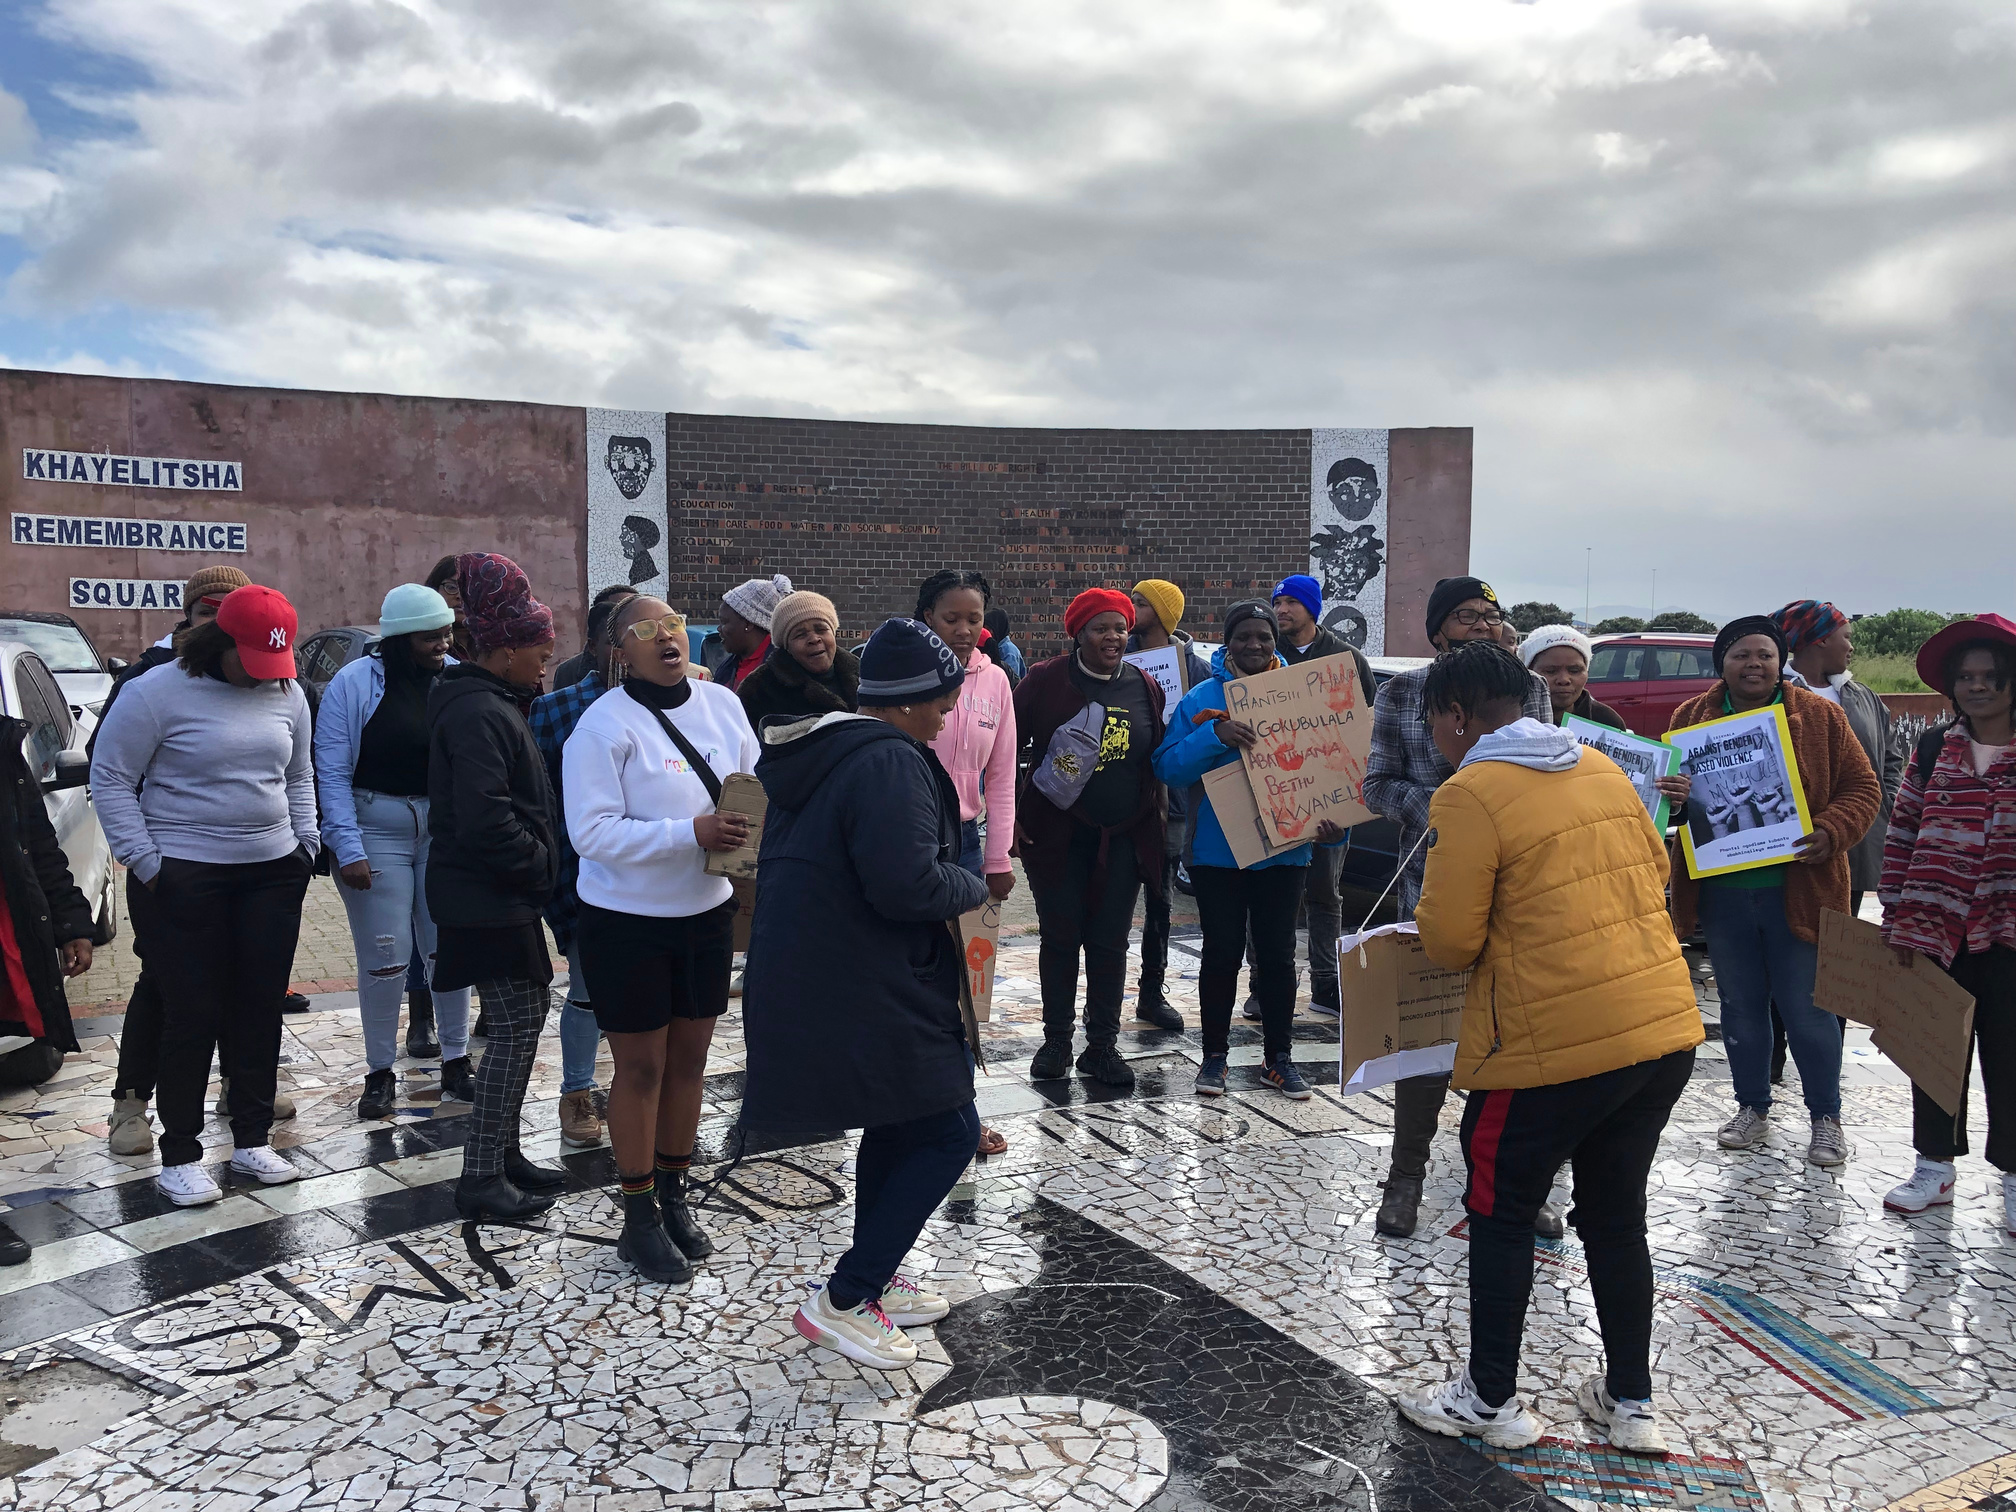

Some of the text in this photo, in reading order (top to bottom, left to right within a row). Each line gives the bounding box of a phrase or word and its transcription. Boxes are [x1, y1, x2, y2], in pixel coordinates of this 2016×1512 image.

[26, 452, 239, 488] KHAYELITSHA
[938, 463, 953, 471] THE
[960, 463, 978, 471] BILL
[988, 463, 999, 472] OF
[704, 482, 737, 492] HAVE
[773, 484, 807, 494] RIGHT
[680, 500, 734, 509] EDUCATION
[1020, 509, 1051, 518] HEALTH
[681, 519, 719, 528] HEALTH
[759, 520, 783, 530] FOOD
[791, 521, 825, 531] WATER
[833, 523, 851, 532] AND
[857, 523, 887, 532] SOCIAL
[899, 525, 940, 534] SECURITY
[14, 516, 245, 550] REMEMBRANCE
[680, 537, 734, 547] EQUALITY
[1008, 545, 1031, 553] JUST
[1038, 545, 1118, 554] ADMINISTRATIVE
[682, 555, 764, 566] HUMAN DIGNITY
[1007, 563, 1056, 571] ACCESS
[1083, 563, 1131, 571] COURTS
[680, 574, 698, 582] LIFE
[1110, 580, 1127, 589] AND
[1210, 580, 1226, 588] ARE
[1232, 580, 1251, 589] NOT
[72, 580, 187, 608] SQUAR
[1006, 597, 1024, 605] YOU
[1030, 597, 1054, 605] HAVE
[1009, 614, 1031, 623] YOUR
[268, 626, 287, 648] NY
[1009, 632, 1025, 640] YOU
[1031, 632, 1047, 640] MAY
[1198, 632, 1209, 640] ON
[903, 617, 962, 677] Sport
[1688, 742, 1721, 761] AGAINST
[1722, 735, 1754, 752] GENDER
[1612, 746, 1642, 766] GENDER
[1690, 750, 1754, 776] BASED VIOLENCE
[1264, 774, 1316, 797] BETHU
[1415, 995, 1443, 1004] Department
[1424, 1010, 1440, 1019] LATEX
